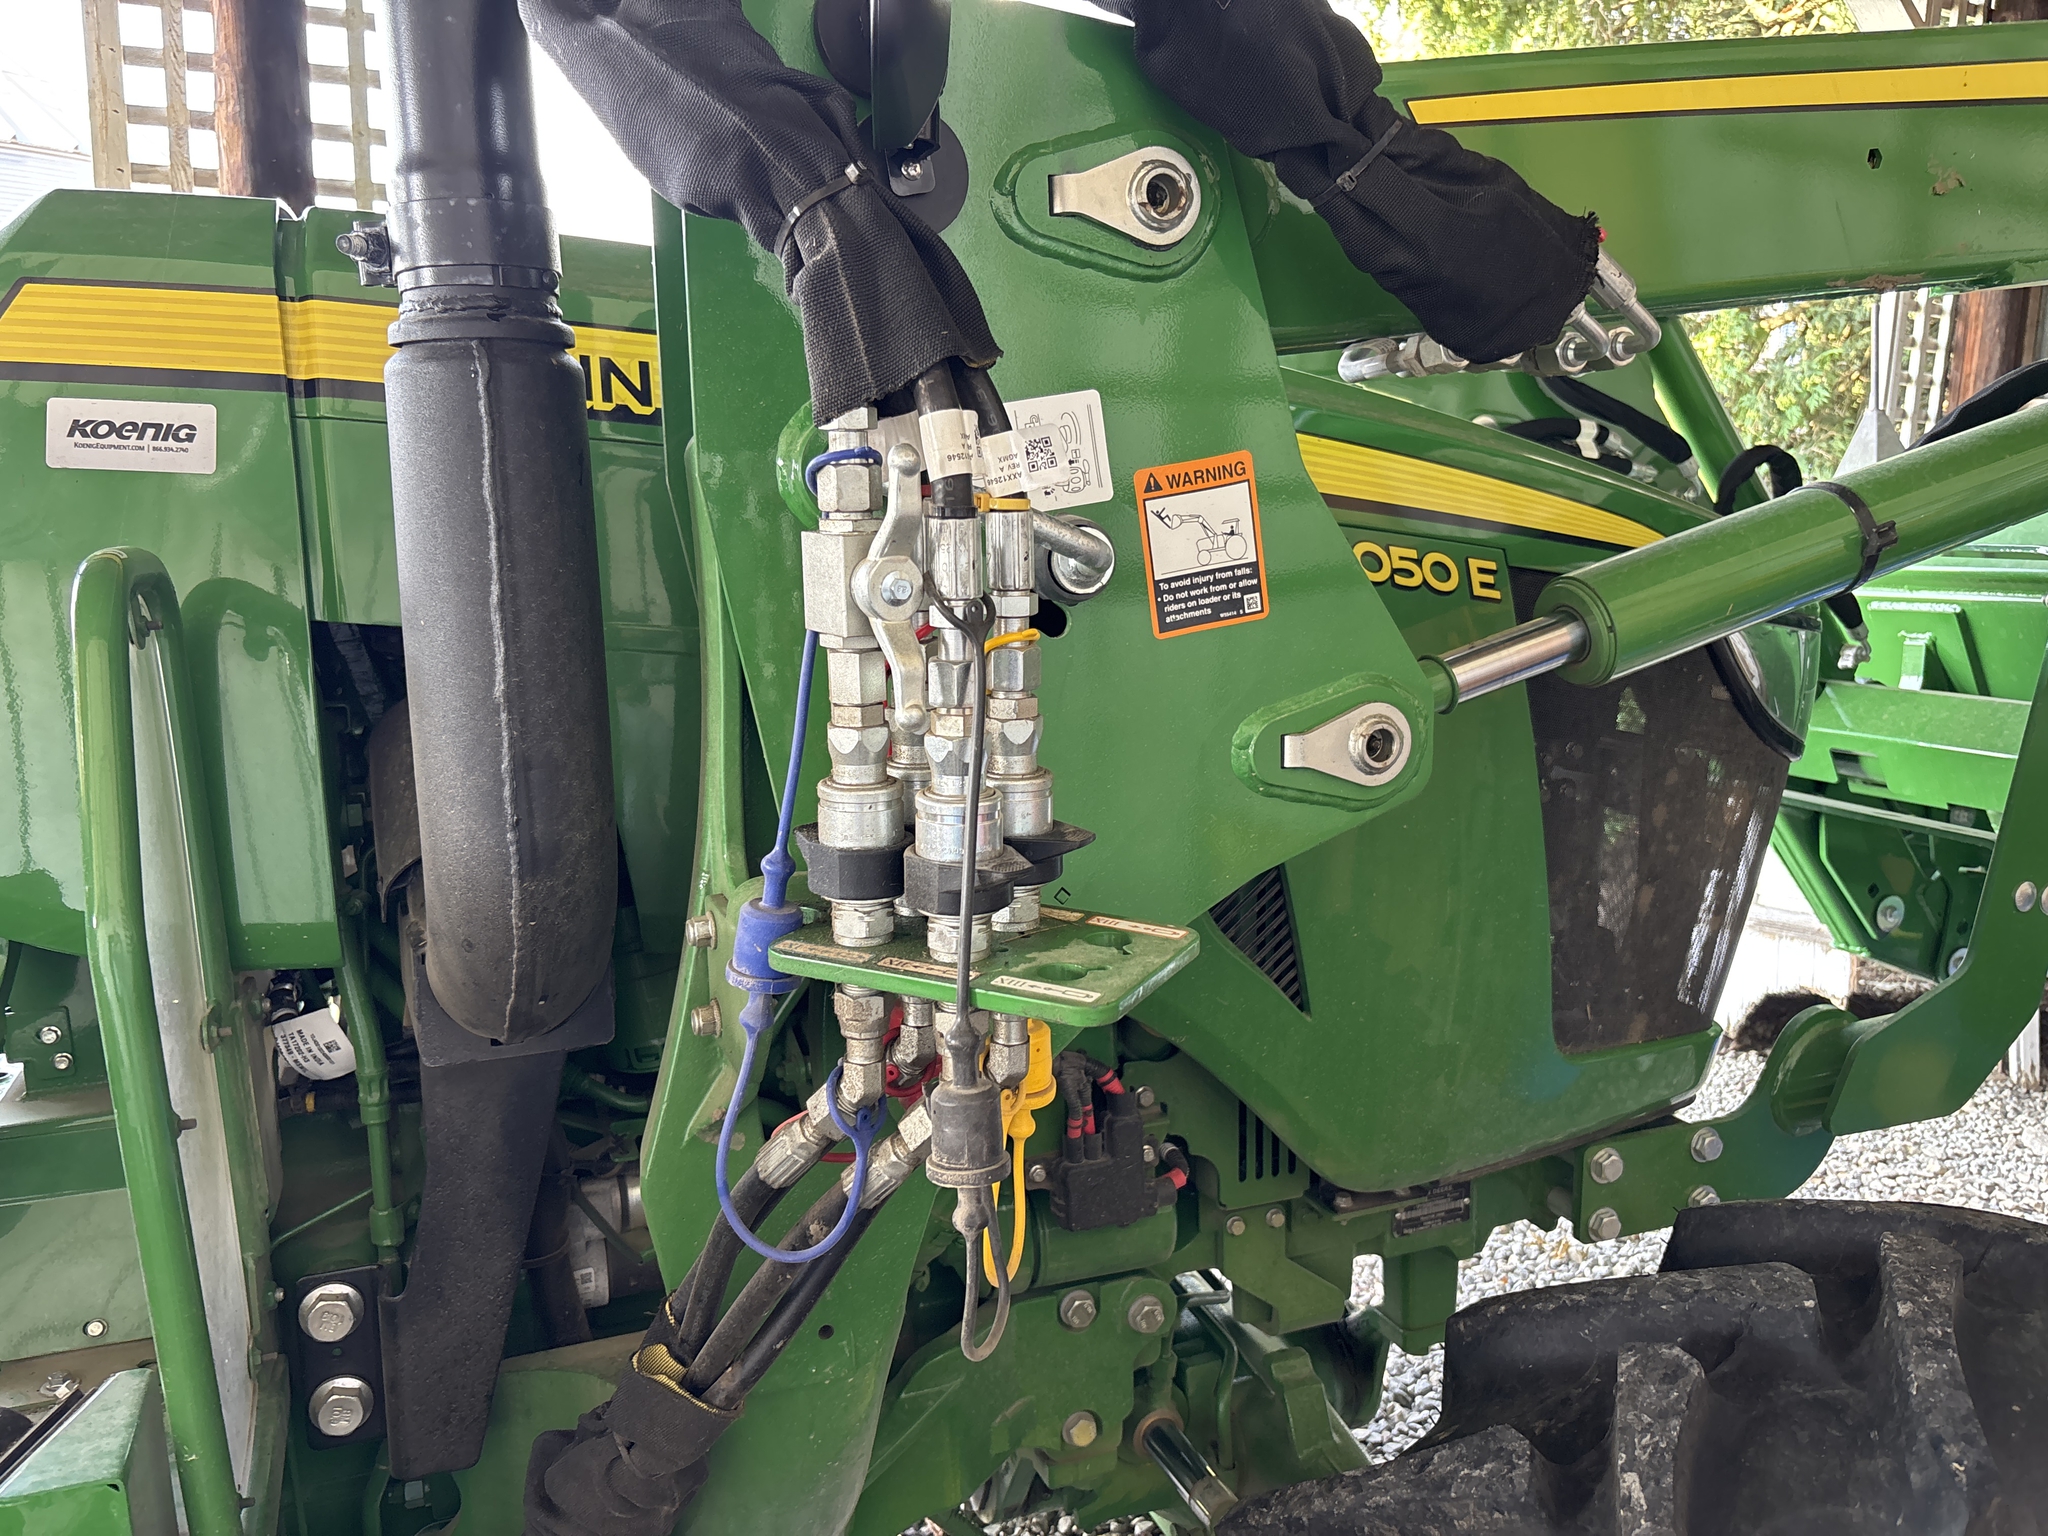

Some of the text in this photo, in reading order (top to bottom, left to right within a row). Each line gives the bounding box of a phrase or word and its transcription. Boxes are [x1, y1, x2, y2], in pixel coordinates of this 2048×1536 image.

[1165, 461, 1246, 489] WARNING
[1159, 567, 1253, 591] To avoid injury from falls:
[1163, 578, 1258, 602] Do not work from or allow
[1467, 557, 1501, 600] E
[1164, 602, 1186, 613] riders
[1198, 595, 1221, 606] loader
[1232, 591, 1241, 599] its
[1165, 607, 1212, 623] attachments
[296, 1028, 309, 1046] MADE
[306, 1046, 313, 1054] IN
[310, 1051, 325, 1066] INDIA
